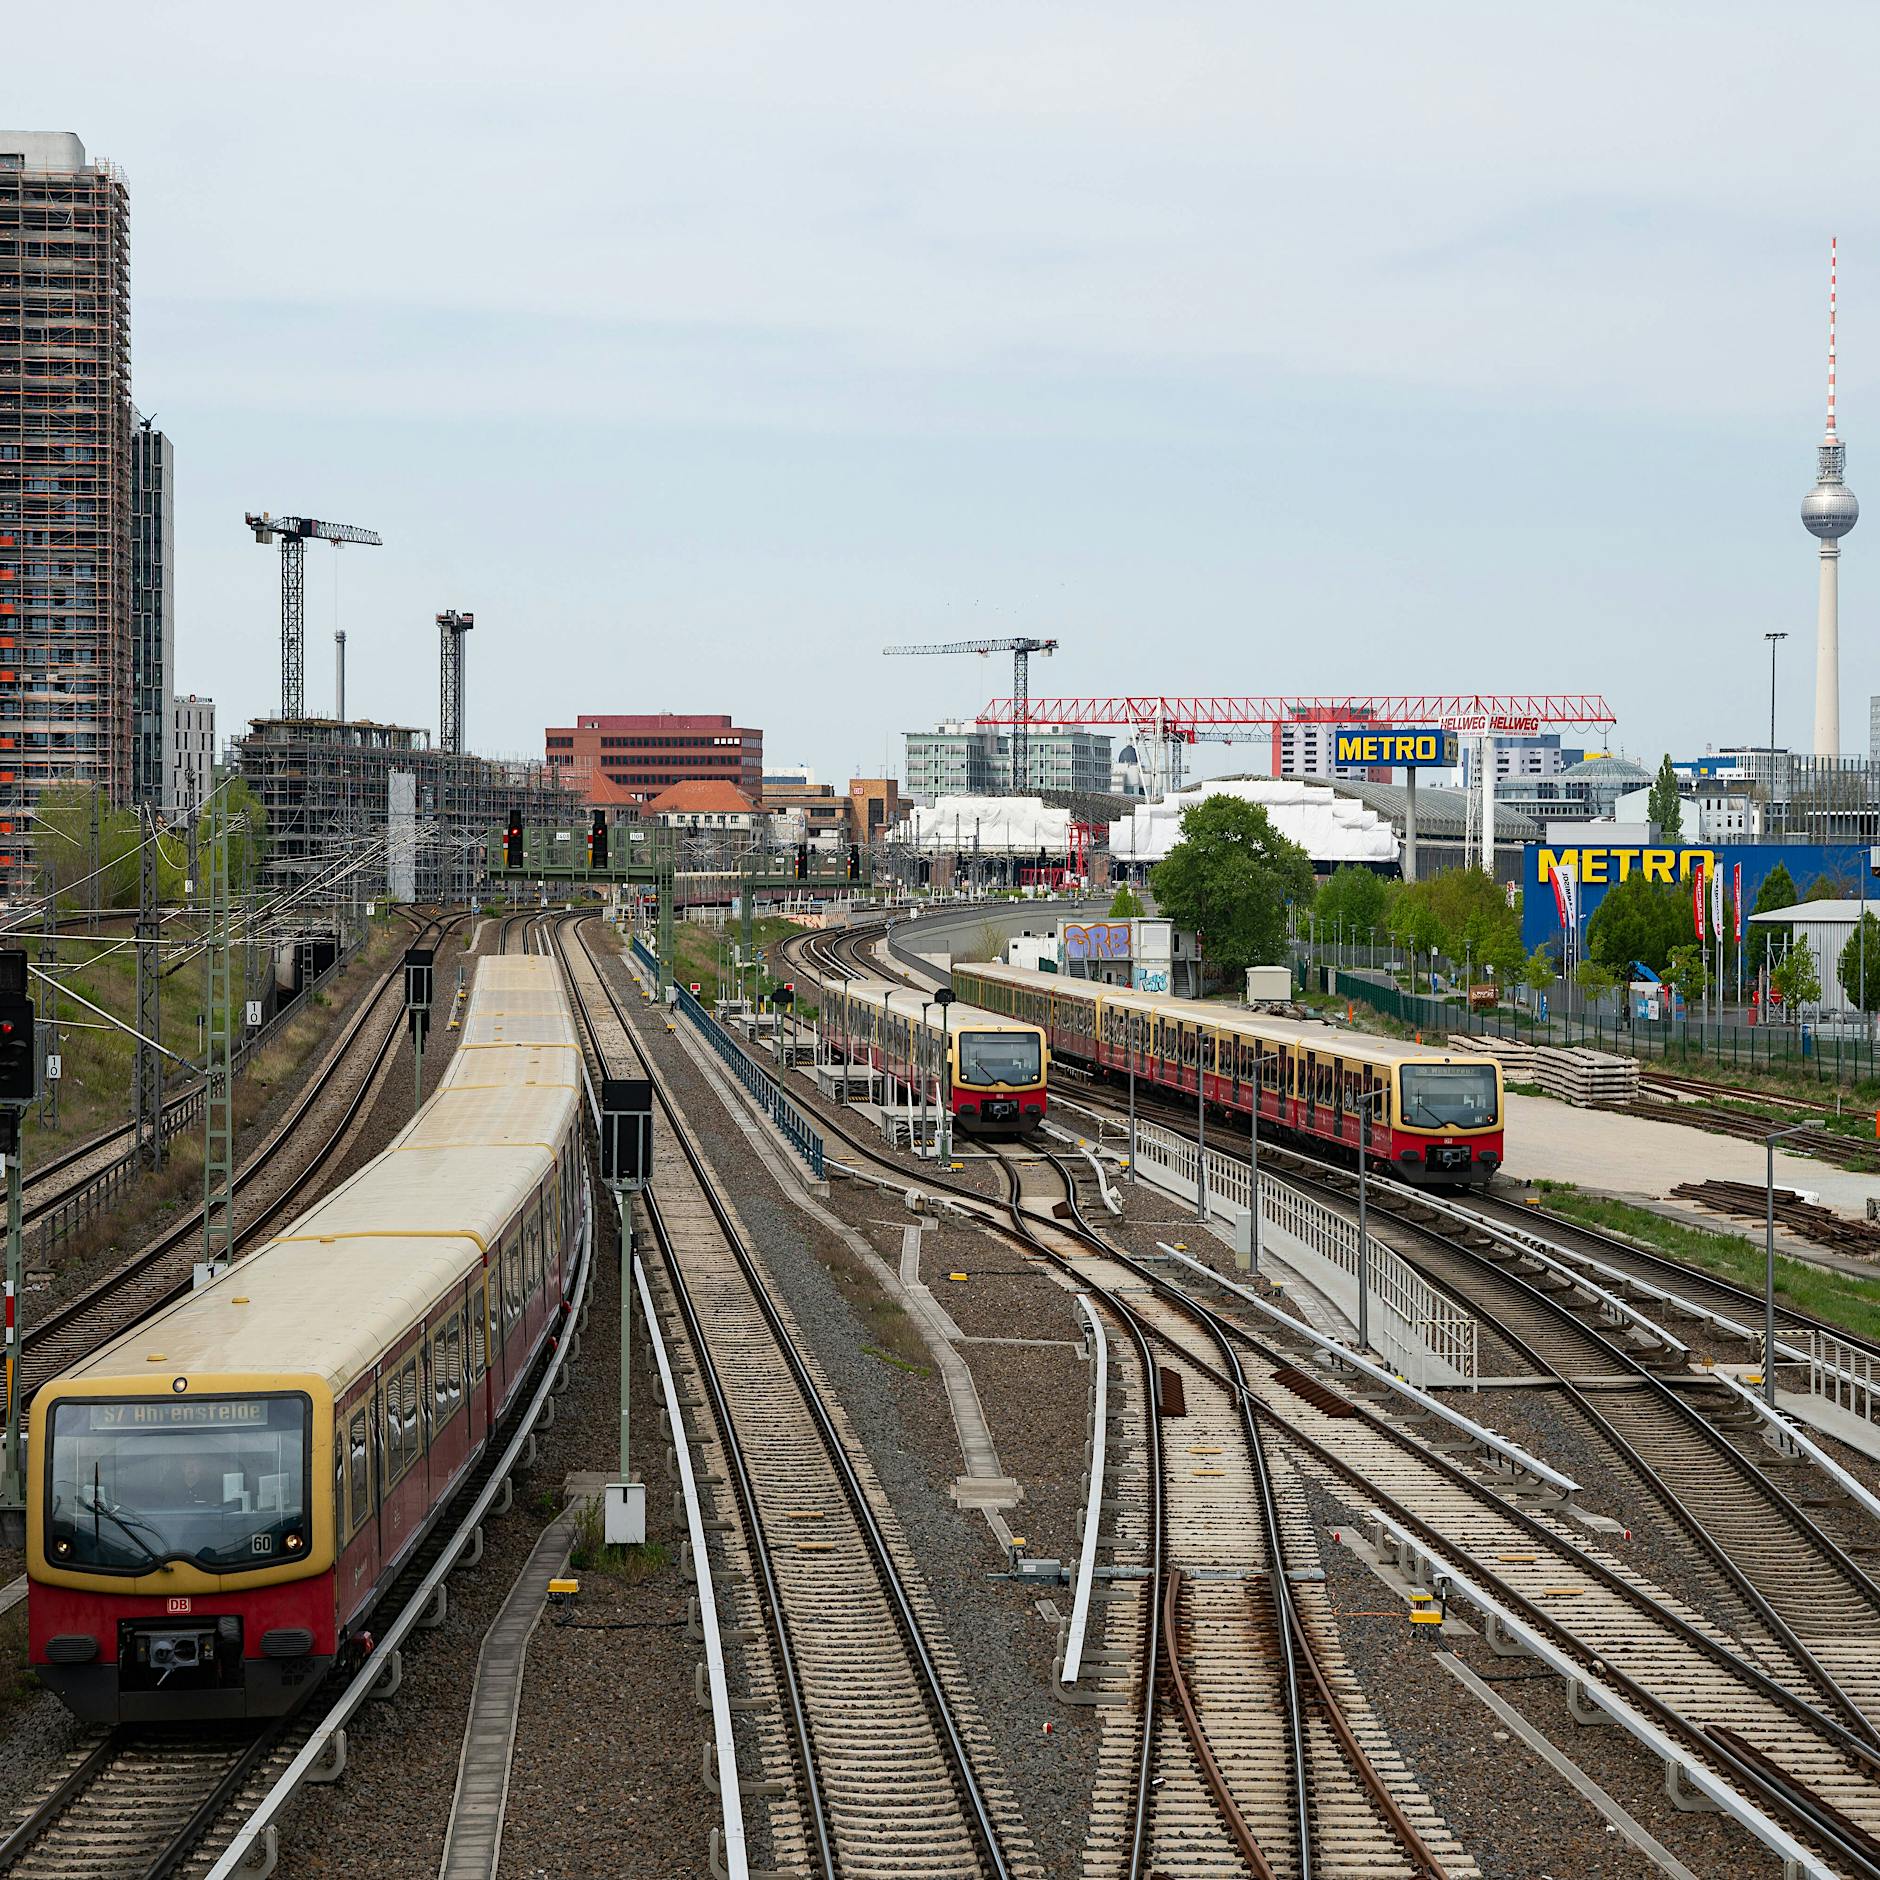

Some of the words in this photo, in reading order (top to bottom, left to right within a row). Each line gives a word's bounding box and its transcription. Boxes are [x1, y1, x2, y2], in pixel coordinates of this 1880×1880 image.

[1440, 716, 1486, 731] HELLWEG
[1489, 716, 1539, 731] HELLWEG
[1338, 736, 1437, 761] METRO
[1538, 849, 1715, 883] METRO
[254, 1536, 271, 1551] 60
[170, 1599, 188, 1611] DB
